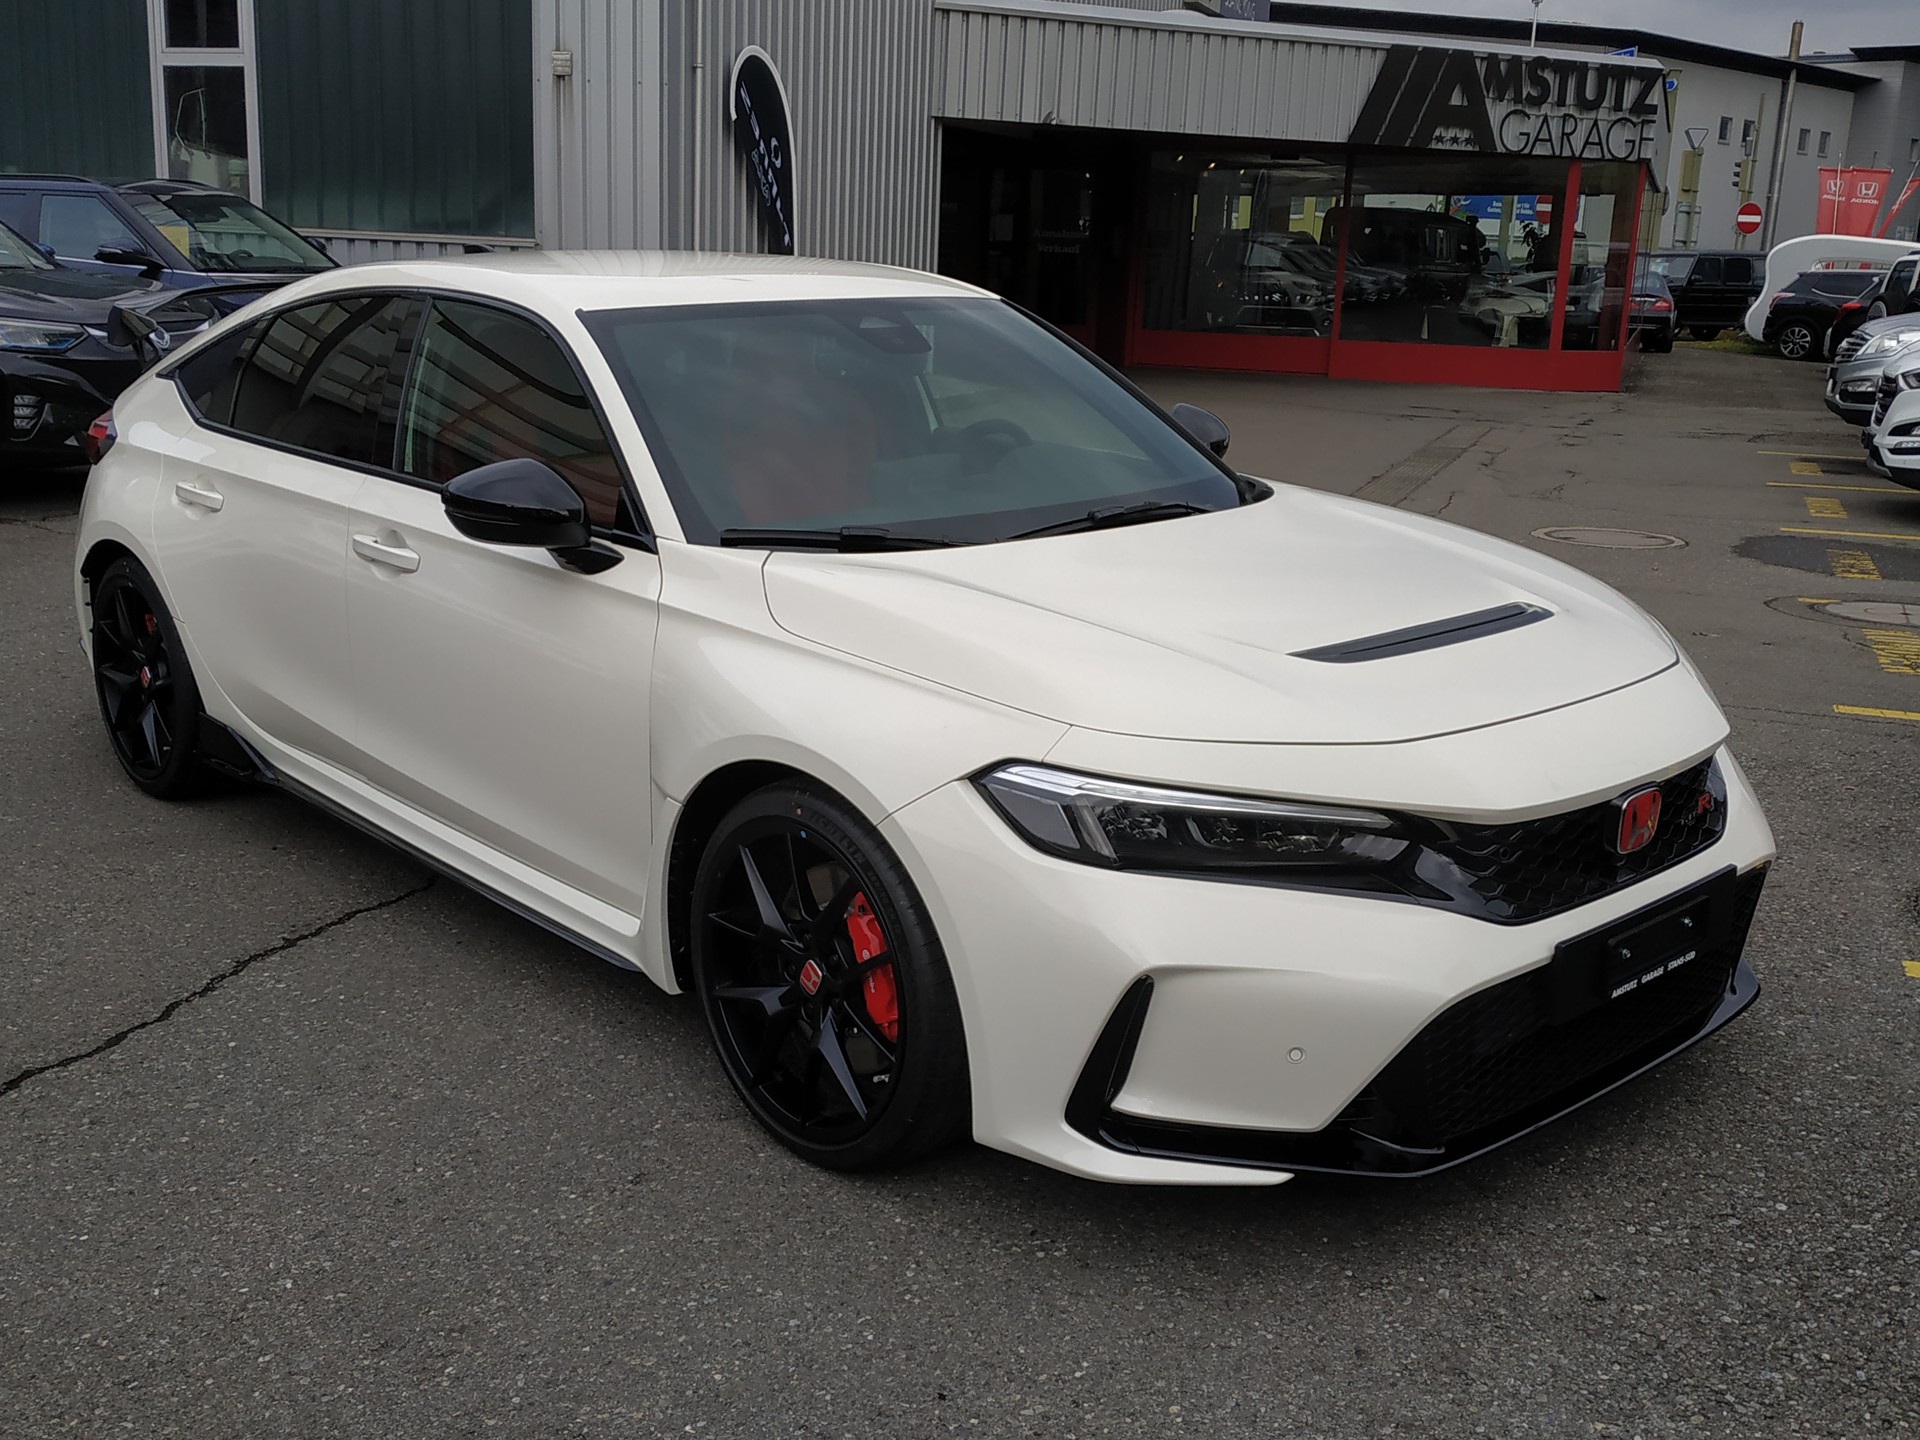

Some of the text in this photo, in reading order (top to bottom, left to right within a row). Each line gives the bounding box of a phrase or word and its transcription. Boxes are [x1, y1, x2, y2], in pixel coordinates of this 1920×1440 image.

[1409, 48, 1667, 152] AMSTUTZ
[1499, 108, 1657, 161] GARAGE
[1610, 978, 1639, 999] AMSTUTZ
[1641, 964, 1665, 984] GARAGE
